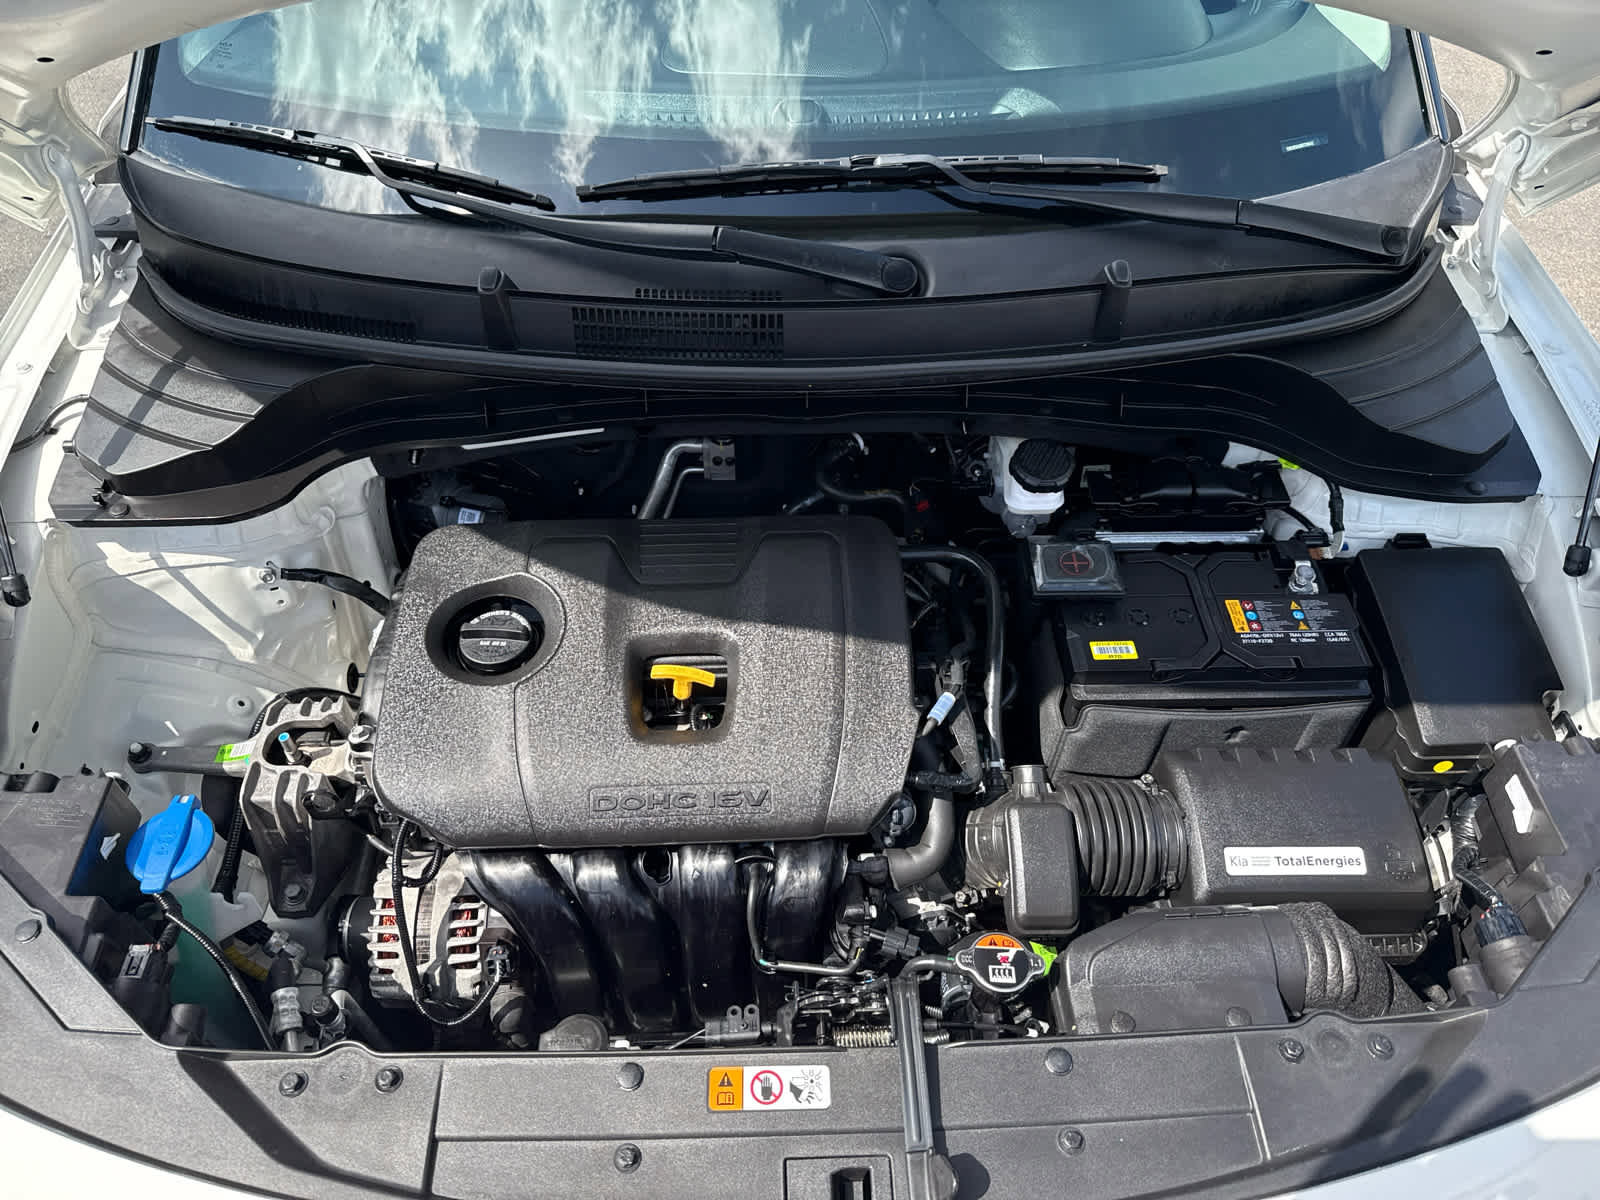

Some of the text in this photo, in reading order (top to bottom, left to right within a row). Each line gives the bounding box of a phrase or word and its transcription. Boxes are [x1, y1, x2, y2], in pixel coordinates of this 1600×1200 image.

[591, 789, 770, 812] DOHC 16V
[1229, 855, 1362, 868] Kia TotalEnergies
